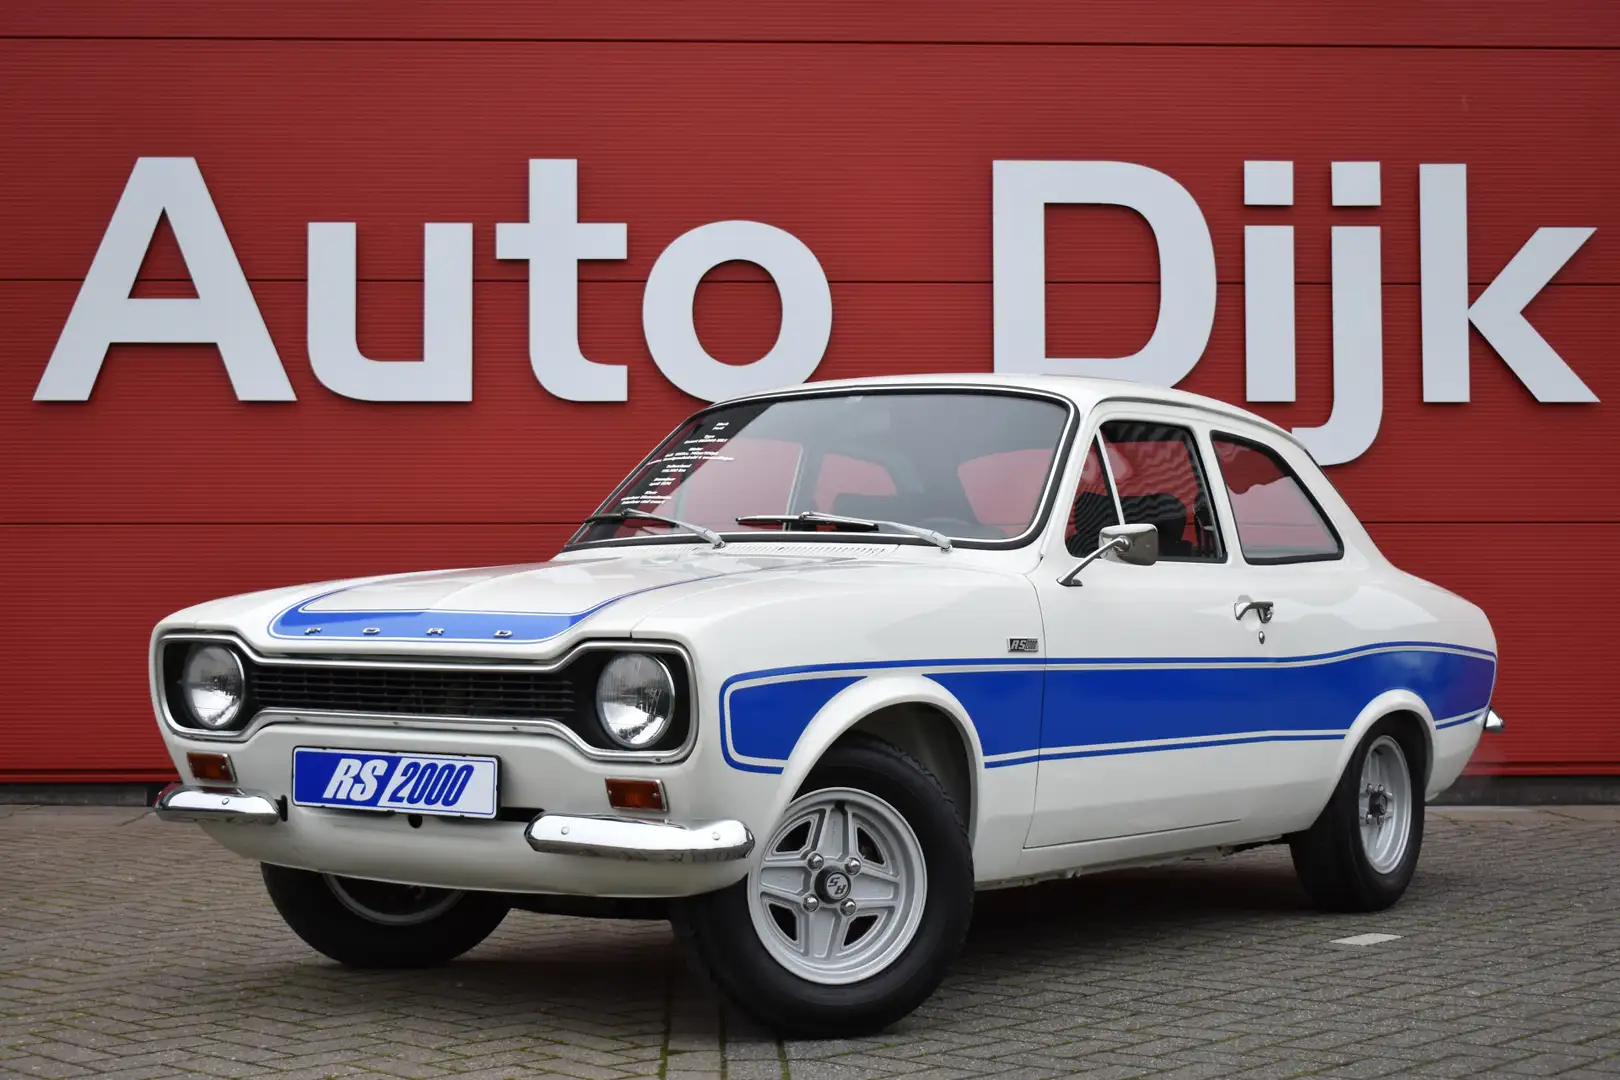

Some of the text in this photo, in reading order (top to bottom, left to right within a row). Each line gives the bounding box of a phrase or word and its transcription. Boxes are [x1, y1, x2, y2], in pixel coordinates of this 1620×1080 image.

[32, 156, 1601, 467] Auto Dijk
[304, 627, 513, 639] FORD
[322, 758, 475, 806] RS 2000
